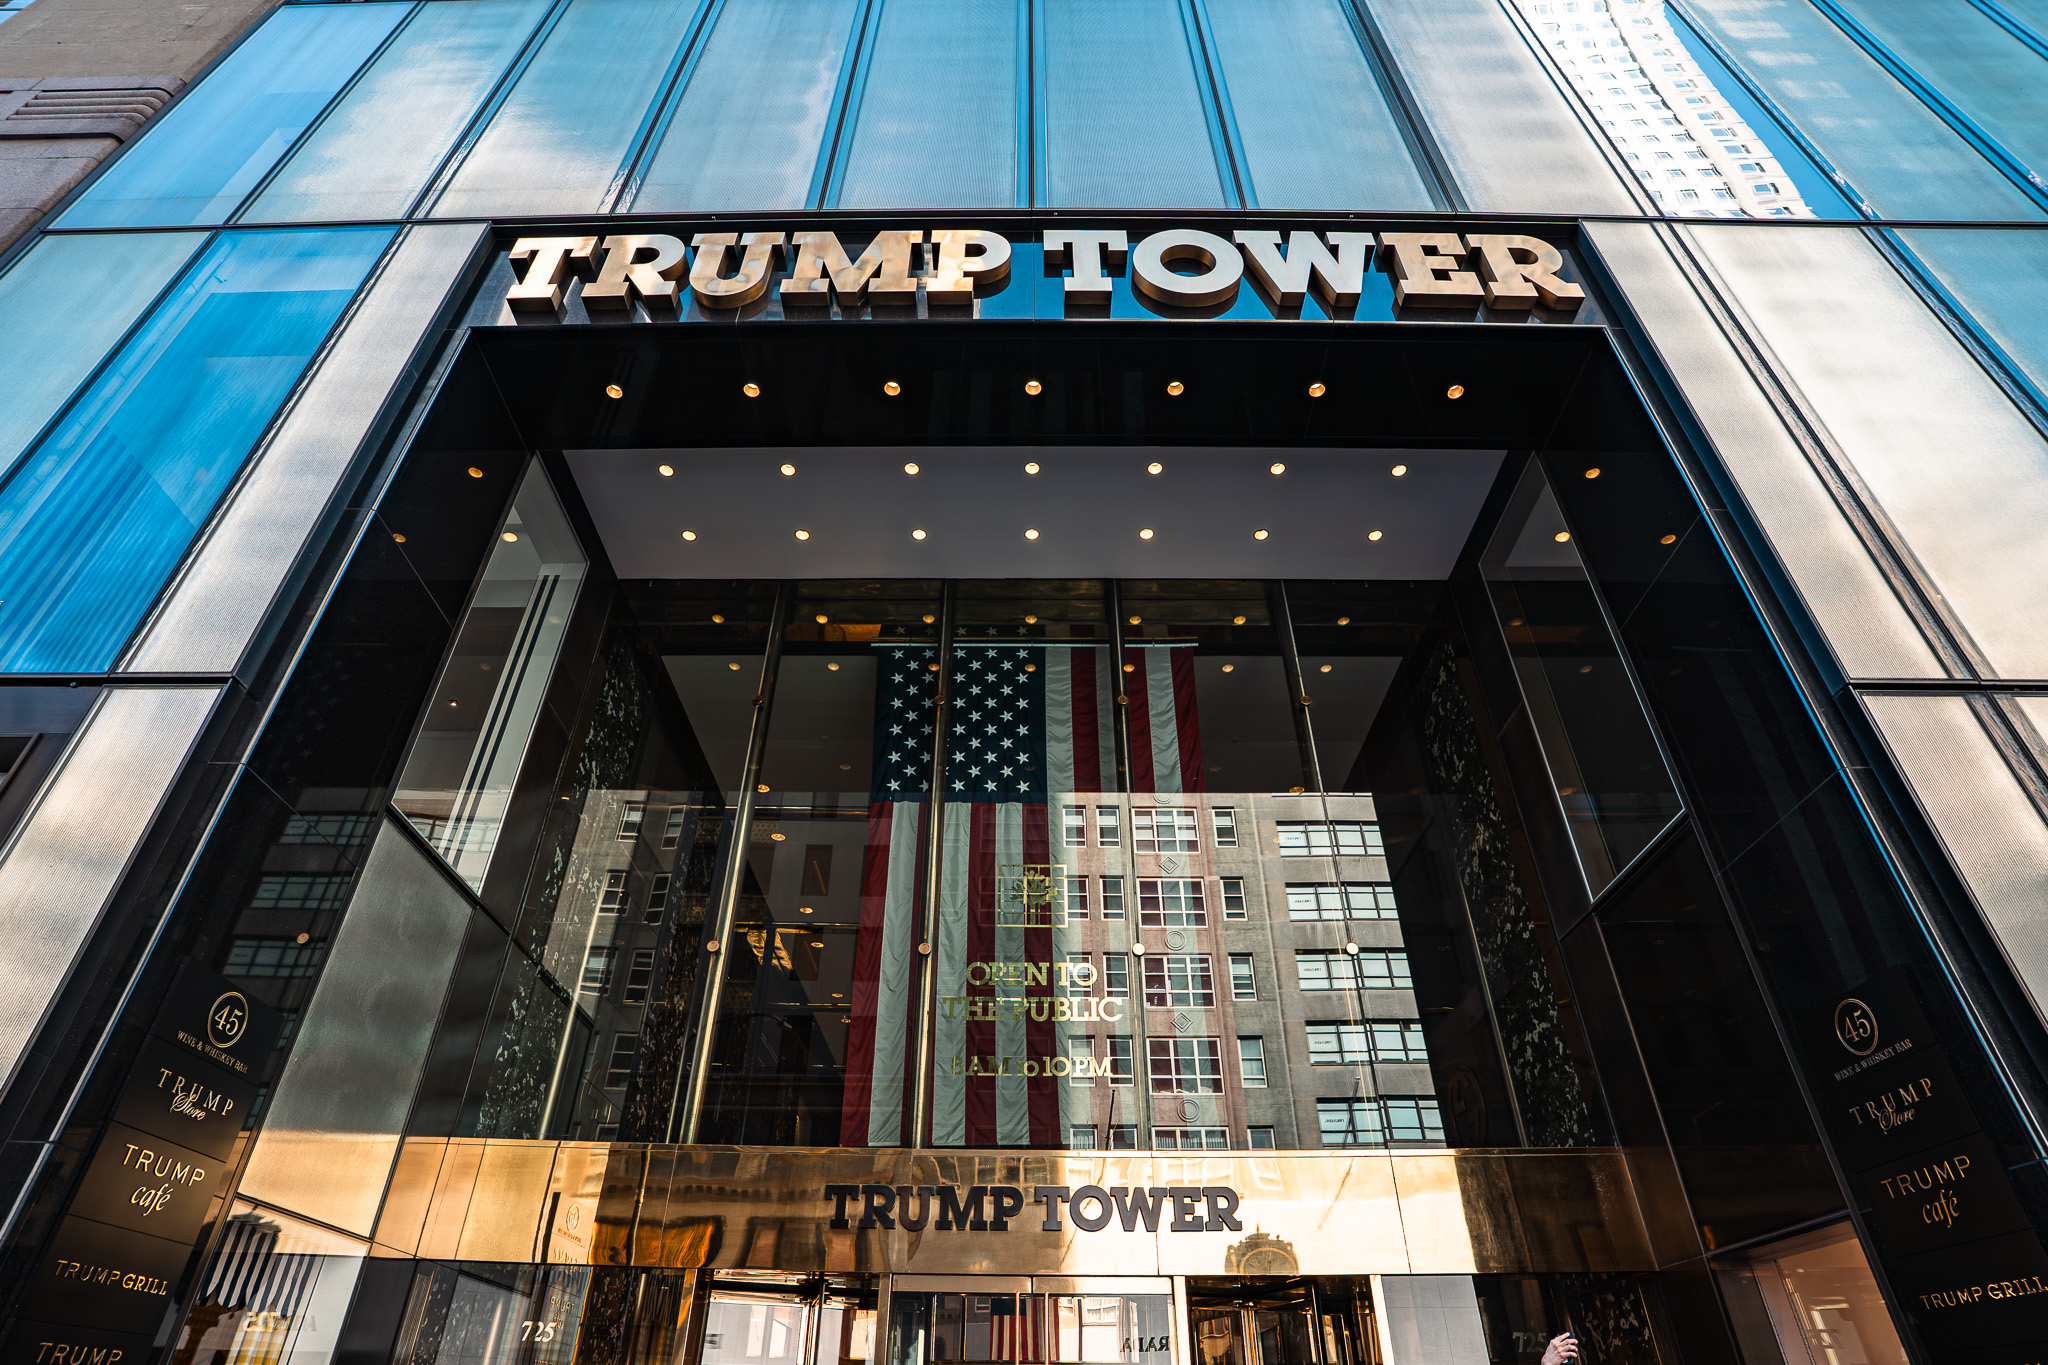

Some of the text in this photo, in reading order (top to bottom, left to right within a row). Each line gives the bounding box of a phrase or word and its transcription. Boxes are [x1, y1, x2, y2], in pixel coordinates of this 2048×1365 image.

[506, 229, 1585, 311] TRUMP TOWER
[966, 961, 1098, 986] OPEN TO
[214, 1005, 243, 1035] 45
[941, 996, 1123, 1022] THE PUBLIC
[1845, 1009, 1871, 1042] 45
[177, 1030, 249, 1074] WINE & WHISKEY BAR
[1834, 1038, 1912, 1081] WINE & WHISKEY BAR
[157, 1068, 234, 1116] TRUMP
[169, 1092, 206, 1122] Store
[1849, 1077, 1934, 1126] TRUMP
[1879, 1105, 1916, 1135] Store
[121, 1144, 206, 1187] TRUMP
[1881, 1155, 1971, 1199] TRUMP
[130, 1183, 172, 1217] café
[825, 1184, 1243, 1232] TRUMP TOWER
[1922, 1190, 1960, 1228] café
[55, 1260, 168, 1296] TRUMP GRILL
[1919, 1276, 2048, 1310] TRUMP GRILL
[521, 1320, 557, 1343] 725
[36, 1342, 124, 1365] TRUMP
